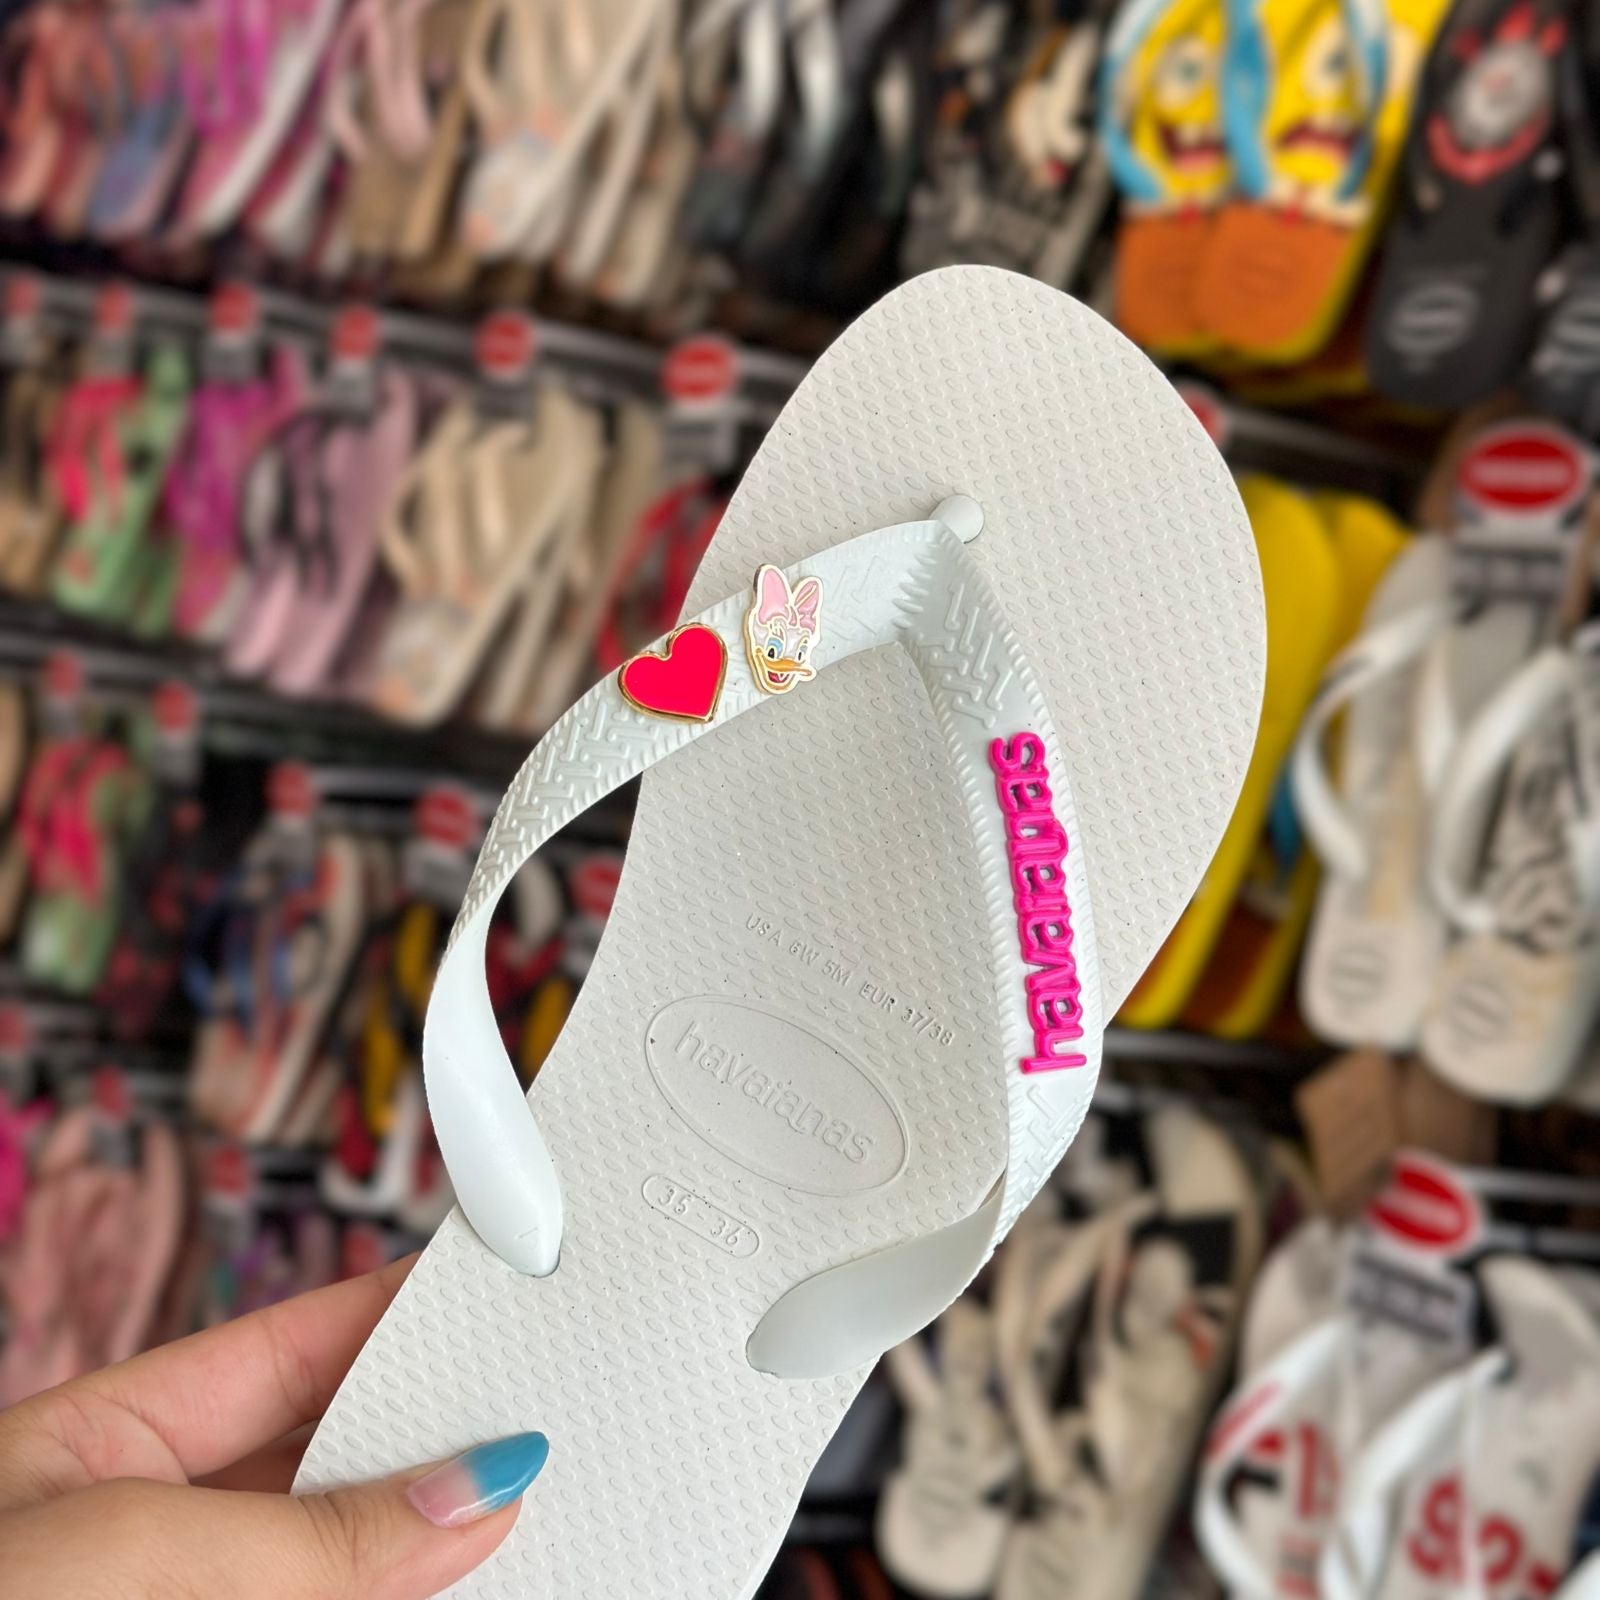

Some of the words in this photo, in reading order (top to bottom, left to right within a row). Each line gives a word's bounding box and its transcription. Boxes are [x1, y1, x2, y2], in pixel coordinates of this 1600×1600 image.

[988, 731, 1087, 1074] havaianas
[745, 913, 783, 946] USA
[789, 942, 820, 966] 6W
[821, 959, 851, 986] 5M
[858, 981, 898, 1013] EUR
[900, 1006, 955, 1046] 37/38
[674, 1020, 876, 1164] havaianas
